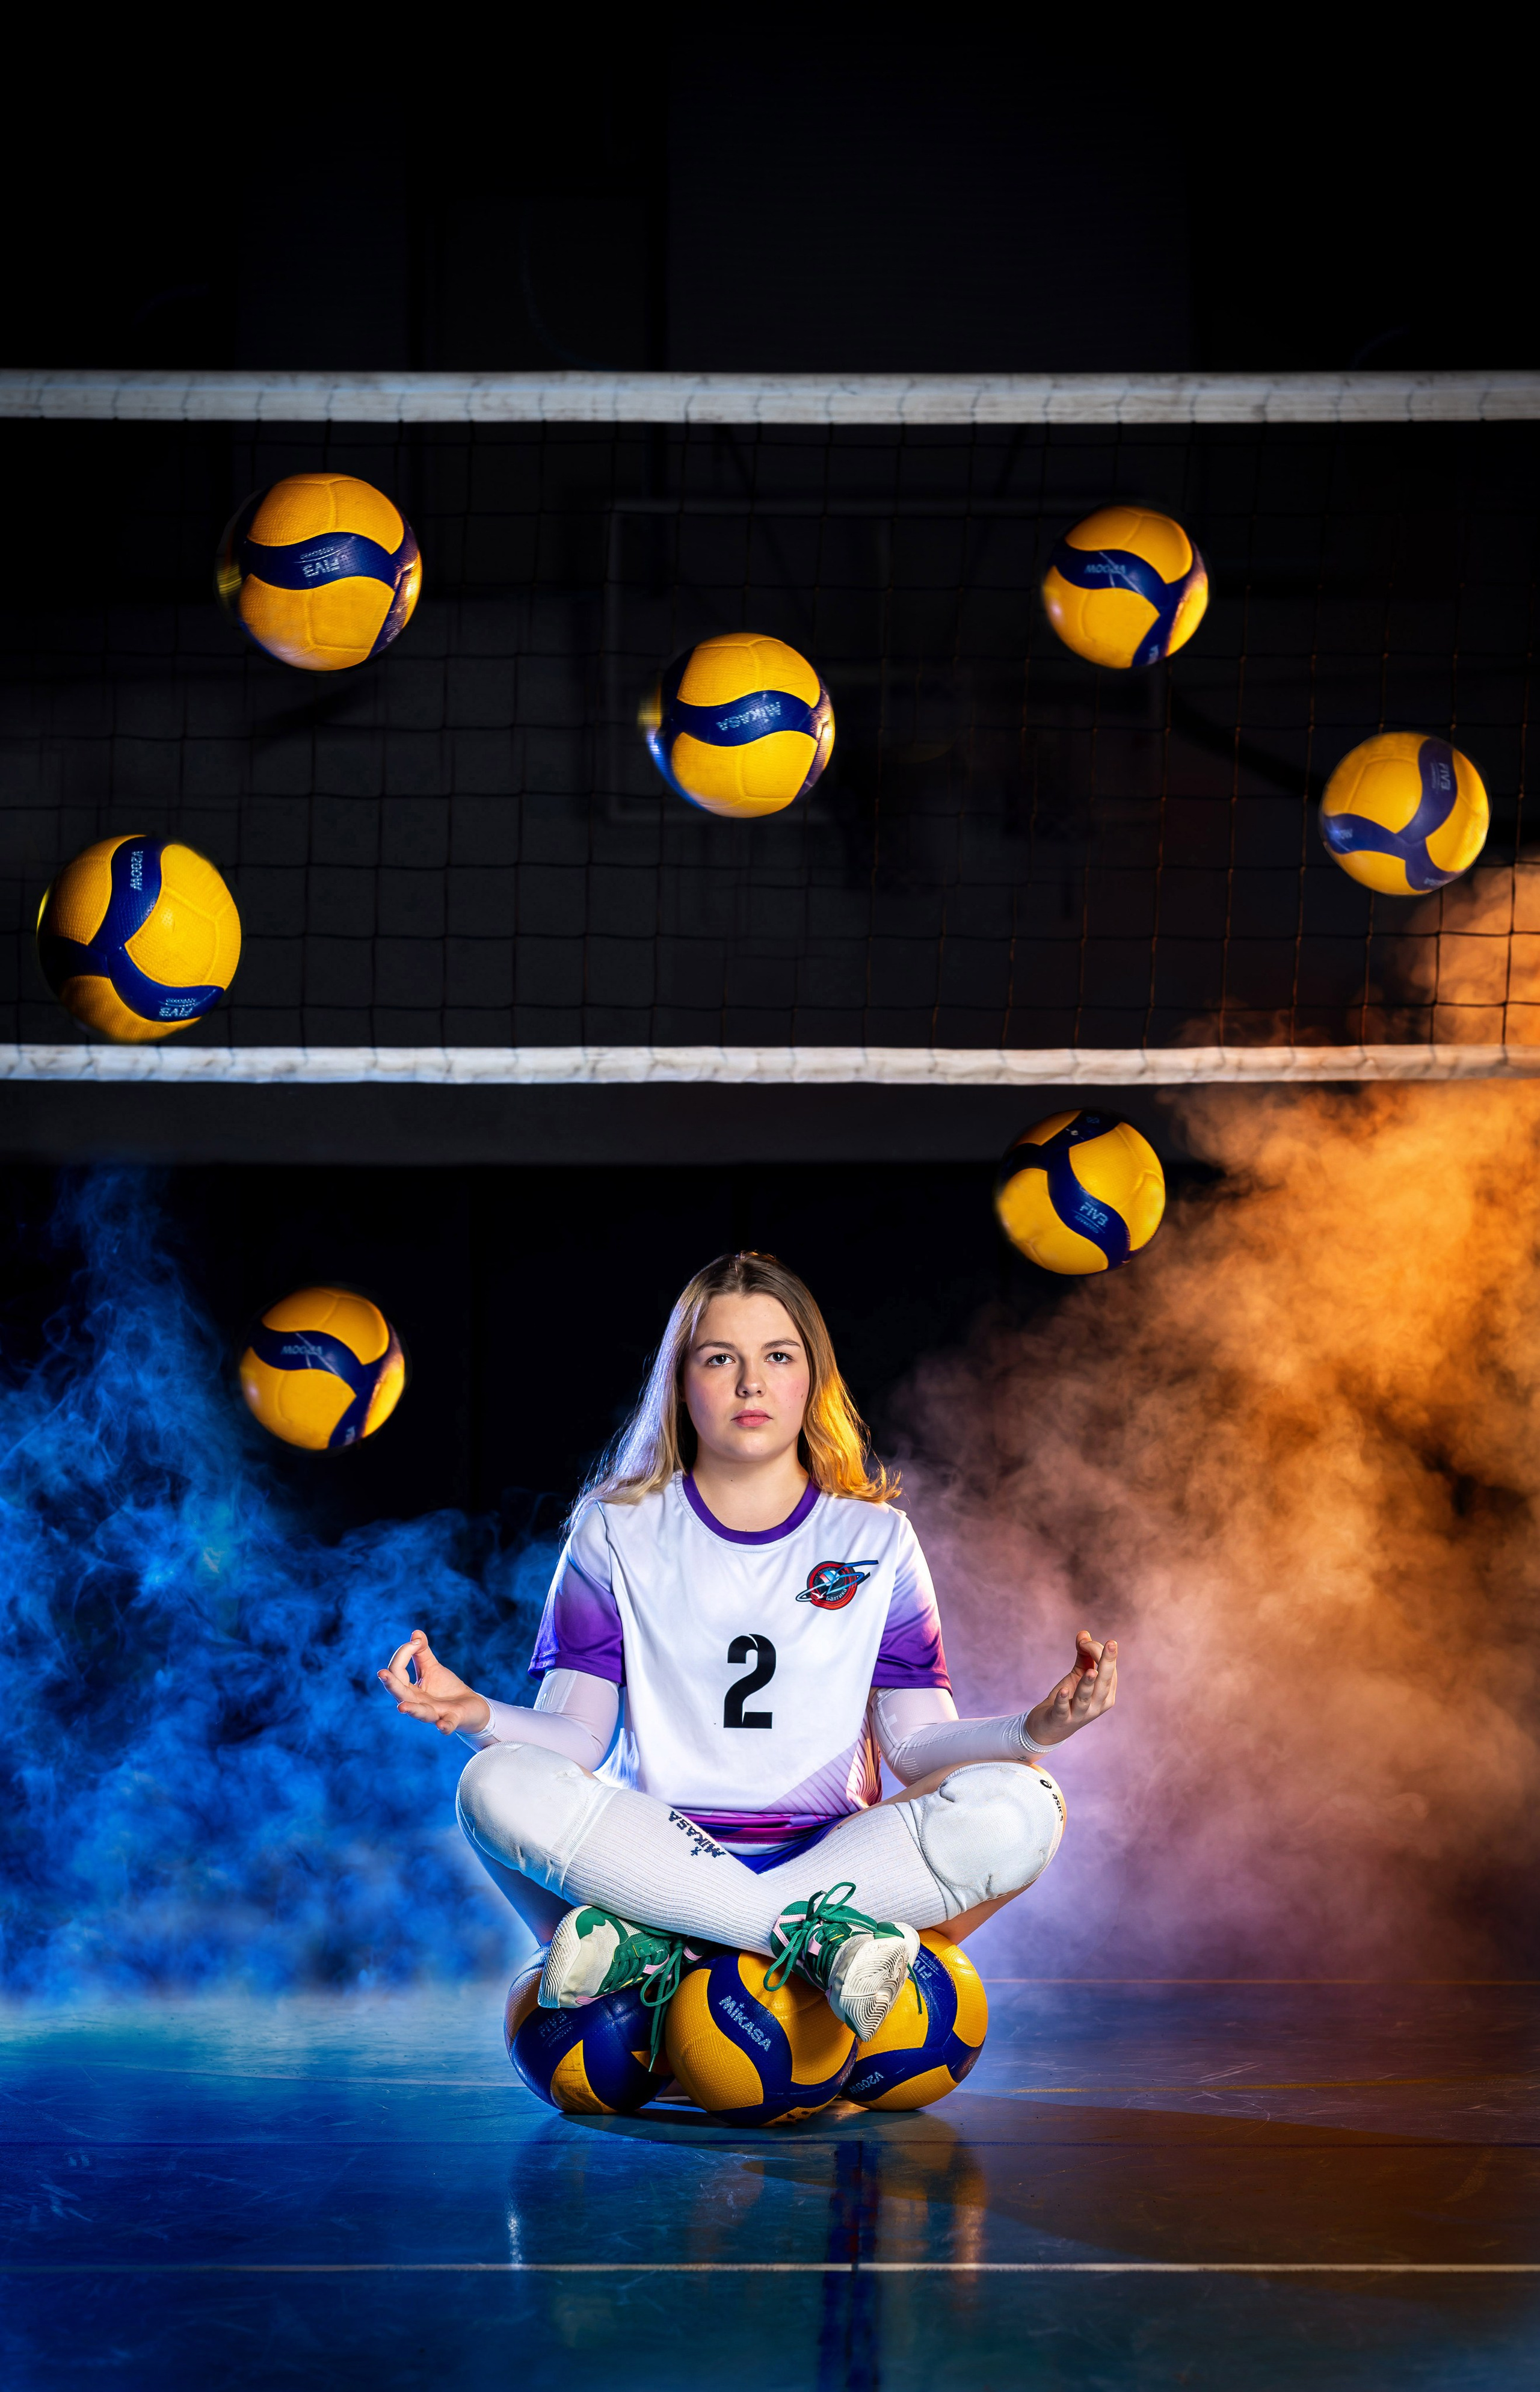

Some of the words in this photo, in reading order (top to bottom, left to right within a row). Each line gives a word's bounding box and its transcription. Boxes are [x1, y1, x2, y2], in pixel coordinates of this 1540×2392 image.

[1438, 762, 1452, 792] FIVB
[130, 851, 144, 891] V200W
[159, 1005, 193, 1017] FIVB
[1080, 1202, 1109, 1227] FIVB
[826, 1588, 847, 1601] Балтика
[723, 1633, 776, 1729] 2
[668, 1811, 726, 1858] MIKASA
[913, 1960, 933, 1980] FIV
[538, 2011, 568, 2038] FIVB
[718, 1995, 771, 2051] MIKASA
[849, 2071, 884, 2094] V200W
